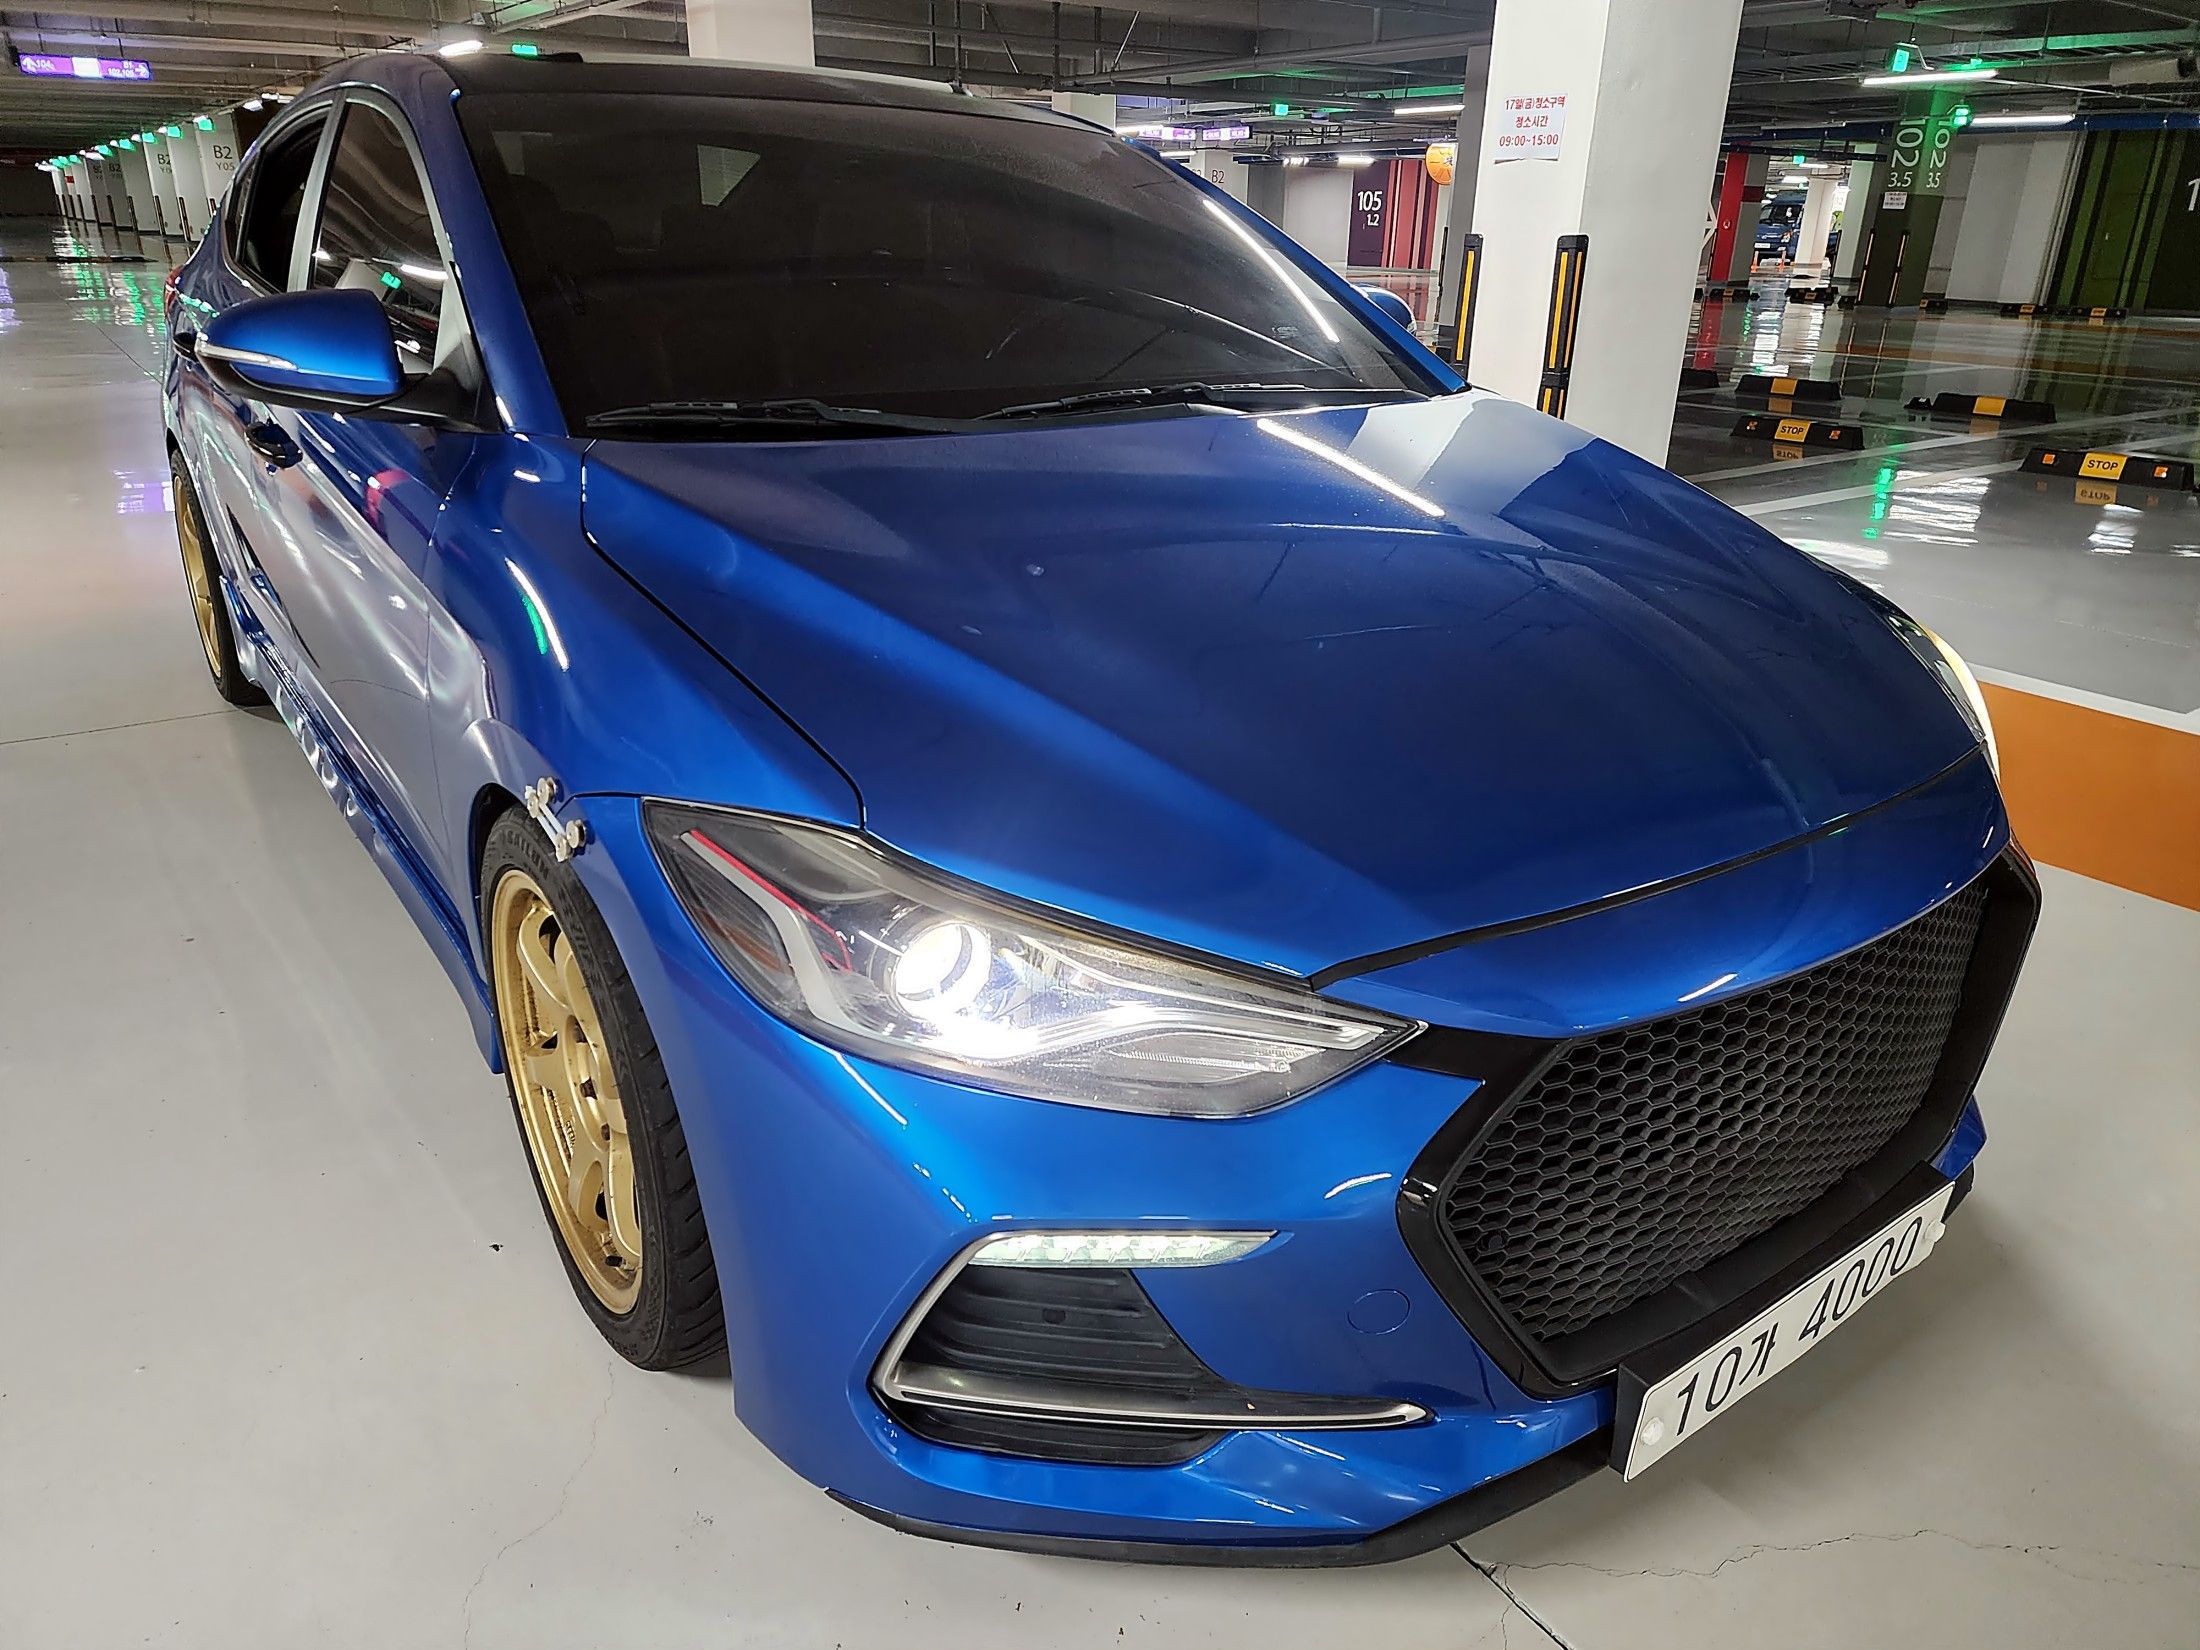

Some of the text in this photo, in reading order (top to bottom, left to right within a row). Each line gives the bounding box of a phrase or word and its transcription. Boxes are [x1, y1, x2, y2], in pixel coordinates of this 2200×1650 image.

[1499, 134, 1559, 147] 09:00~15:00
[1891, 119, 1926, 168] 102
[212, 145, 233, 160] B2
[1211, 169, 1225, 184] B2
[1888, 171, 1913, 187] 3.5
[1357, 190, 1383, 212] 105
[1780, 425, 1804, 435] STOP
[2087, 459, 2119, 471] STOP
[1676, 1216, 1923, 1437] 10가 4000
